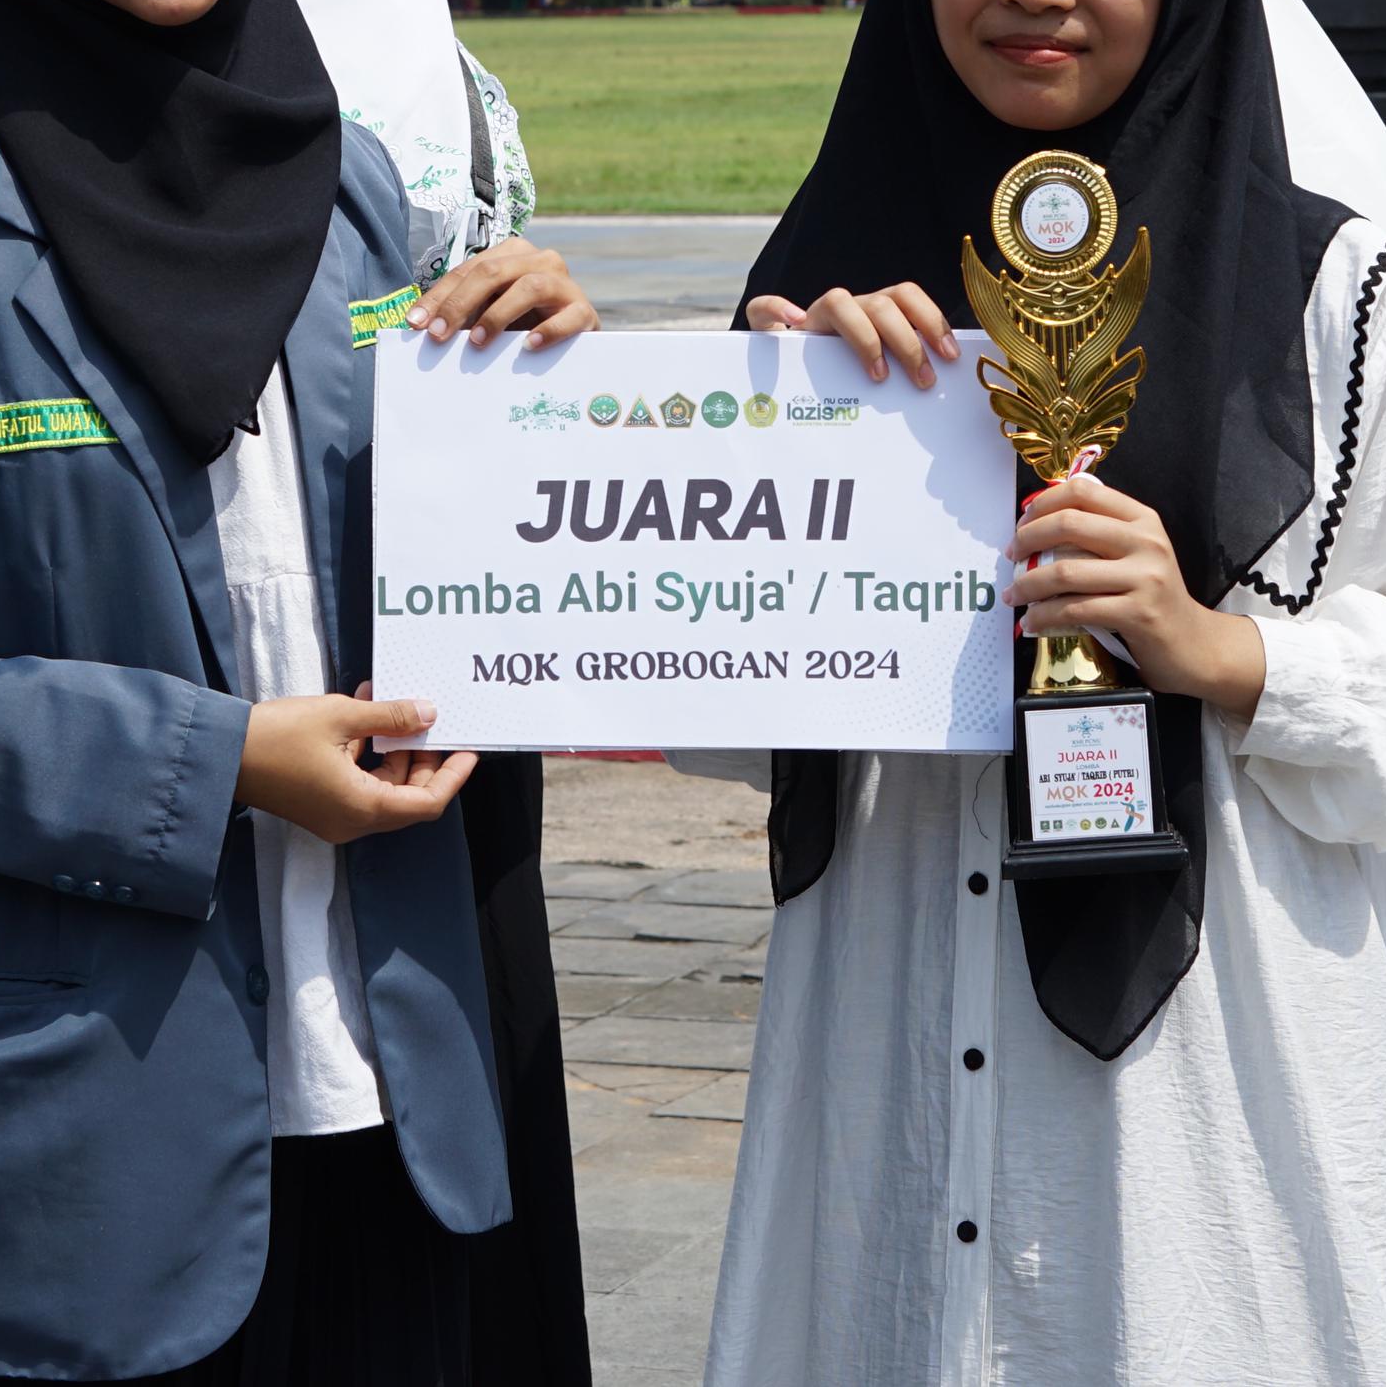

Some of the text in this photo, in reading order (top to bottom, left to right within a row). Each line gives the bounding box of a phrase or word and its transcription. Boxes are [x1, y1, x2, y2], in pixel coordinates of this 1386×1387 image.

[1038, 221, 1075, 236] MQK
[823, 397, 859, 405] nu care
[50, 411, 108, 432] UMAYY
[787, 403, 860, 421] lazisnu
[515, 479, 855, 543] JUARA II
[377, 573, 541, 616] Lomba
[558, 571, 637, 614] Abi
[654, 570, 795, 623] Syuja'
[844, 570, 997, 622] Taqrib
[471, 649, 901, 686] MQK GROBOGAN 2024
[1058, 749, 1117, 763] JUARA II
[1039, 774, 1051, 783] ABI
[1082, 771, 1107, 781] TAQRIB
[1046, 782, 1134, 802] MQK 2024
